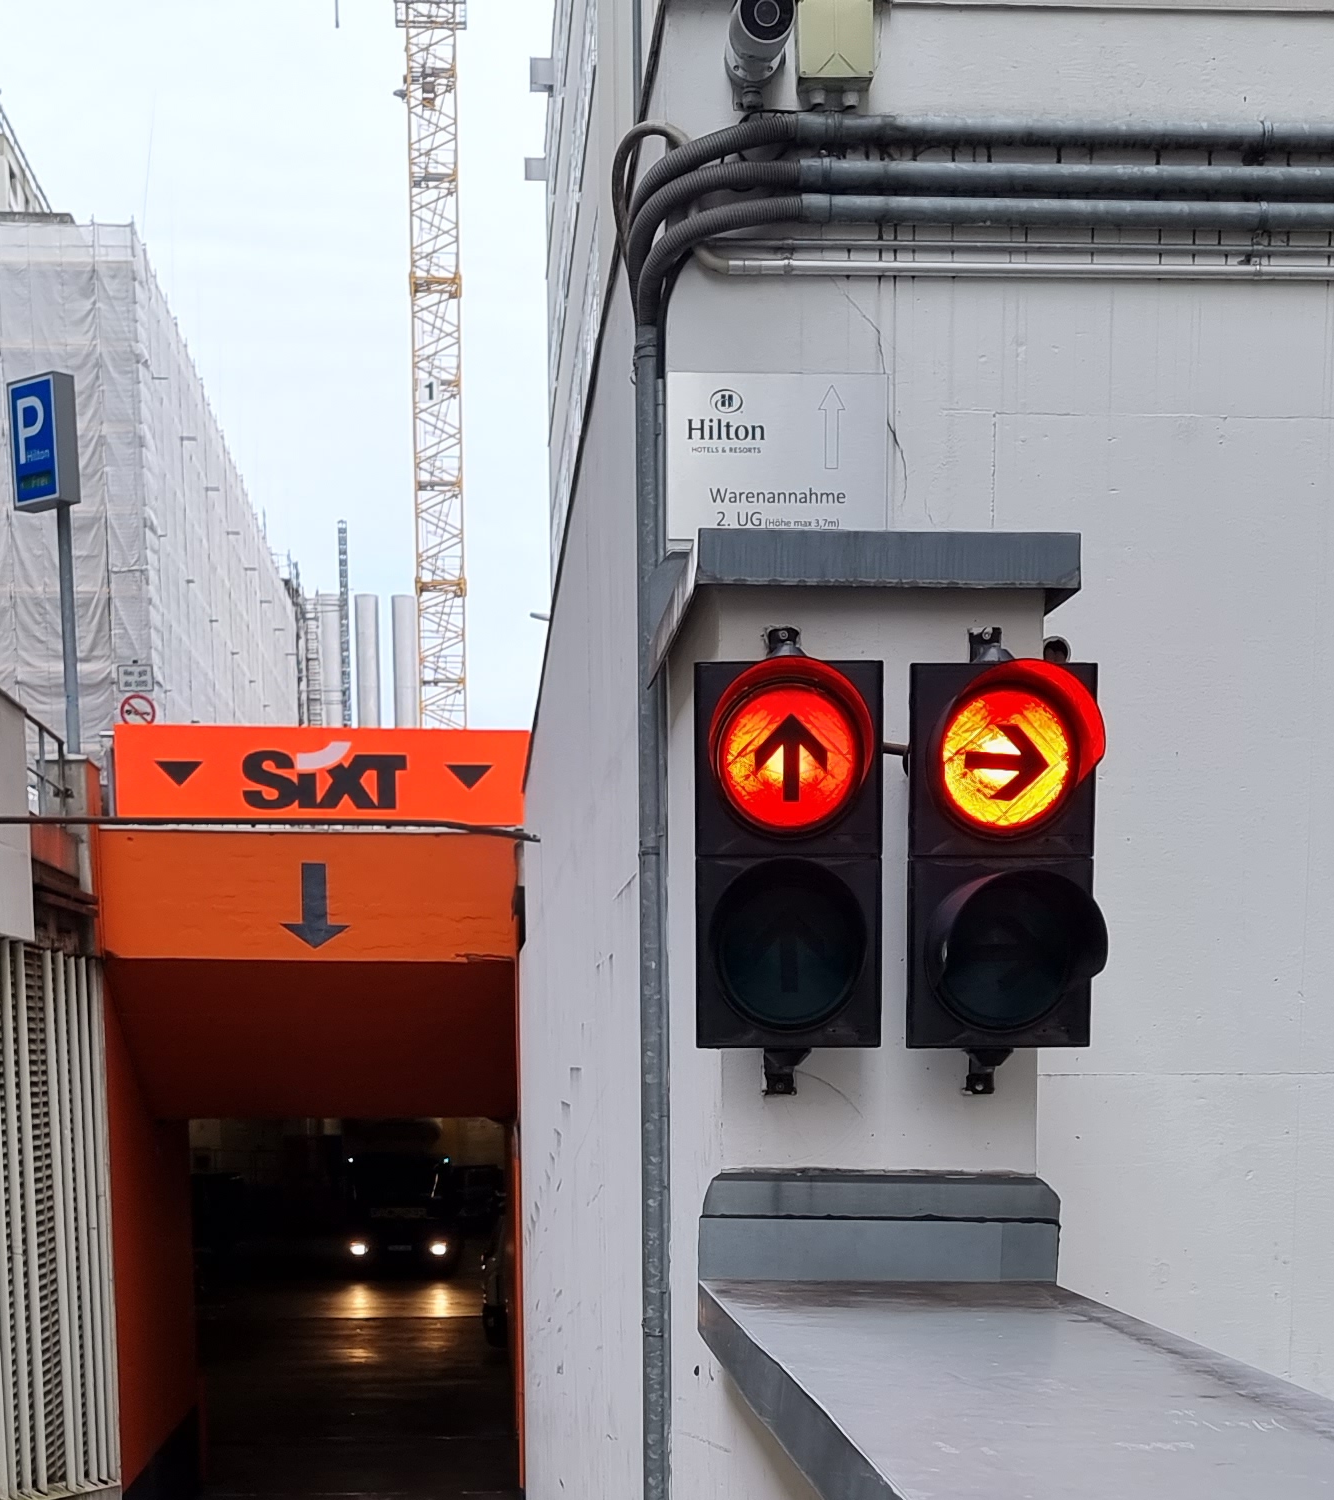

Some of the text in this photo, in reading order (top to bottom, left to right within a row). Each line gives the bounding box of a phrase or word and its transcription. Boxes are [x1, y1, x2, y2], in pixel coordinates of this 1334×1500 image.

[424, 381, 434, 401] 1
[17, 395, 44, 465] P
[687, 418, 766, 441] Hilton
[691, 446, 762, 454] HOTELS & RESORTS
[709, 487, 846, 505] Warenannahme
[716, 511, 840, 530] 2. UG (Höhe max 3,7m)
